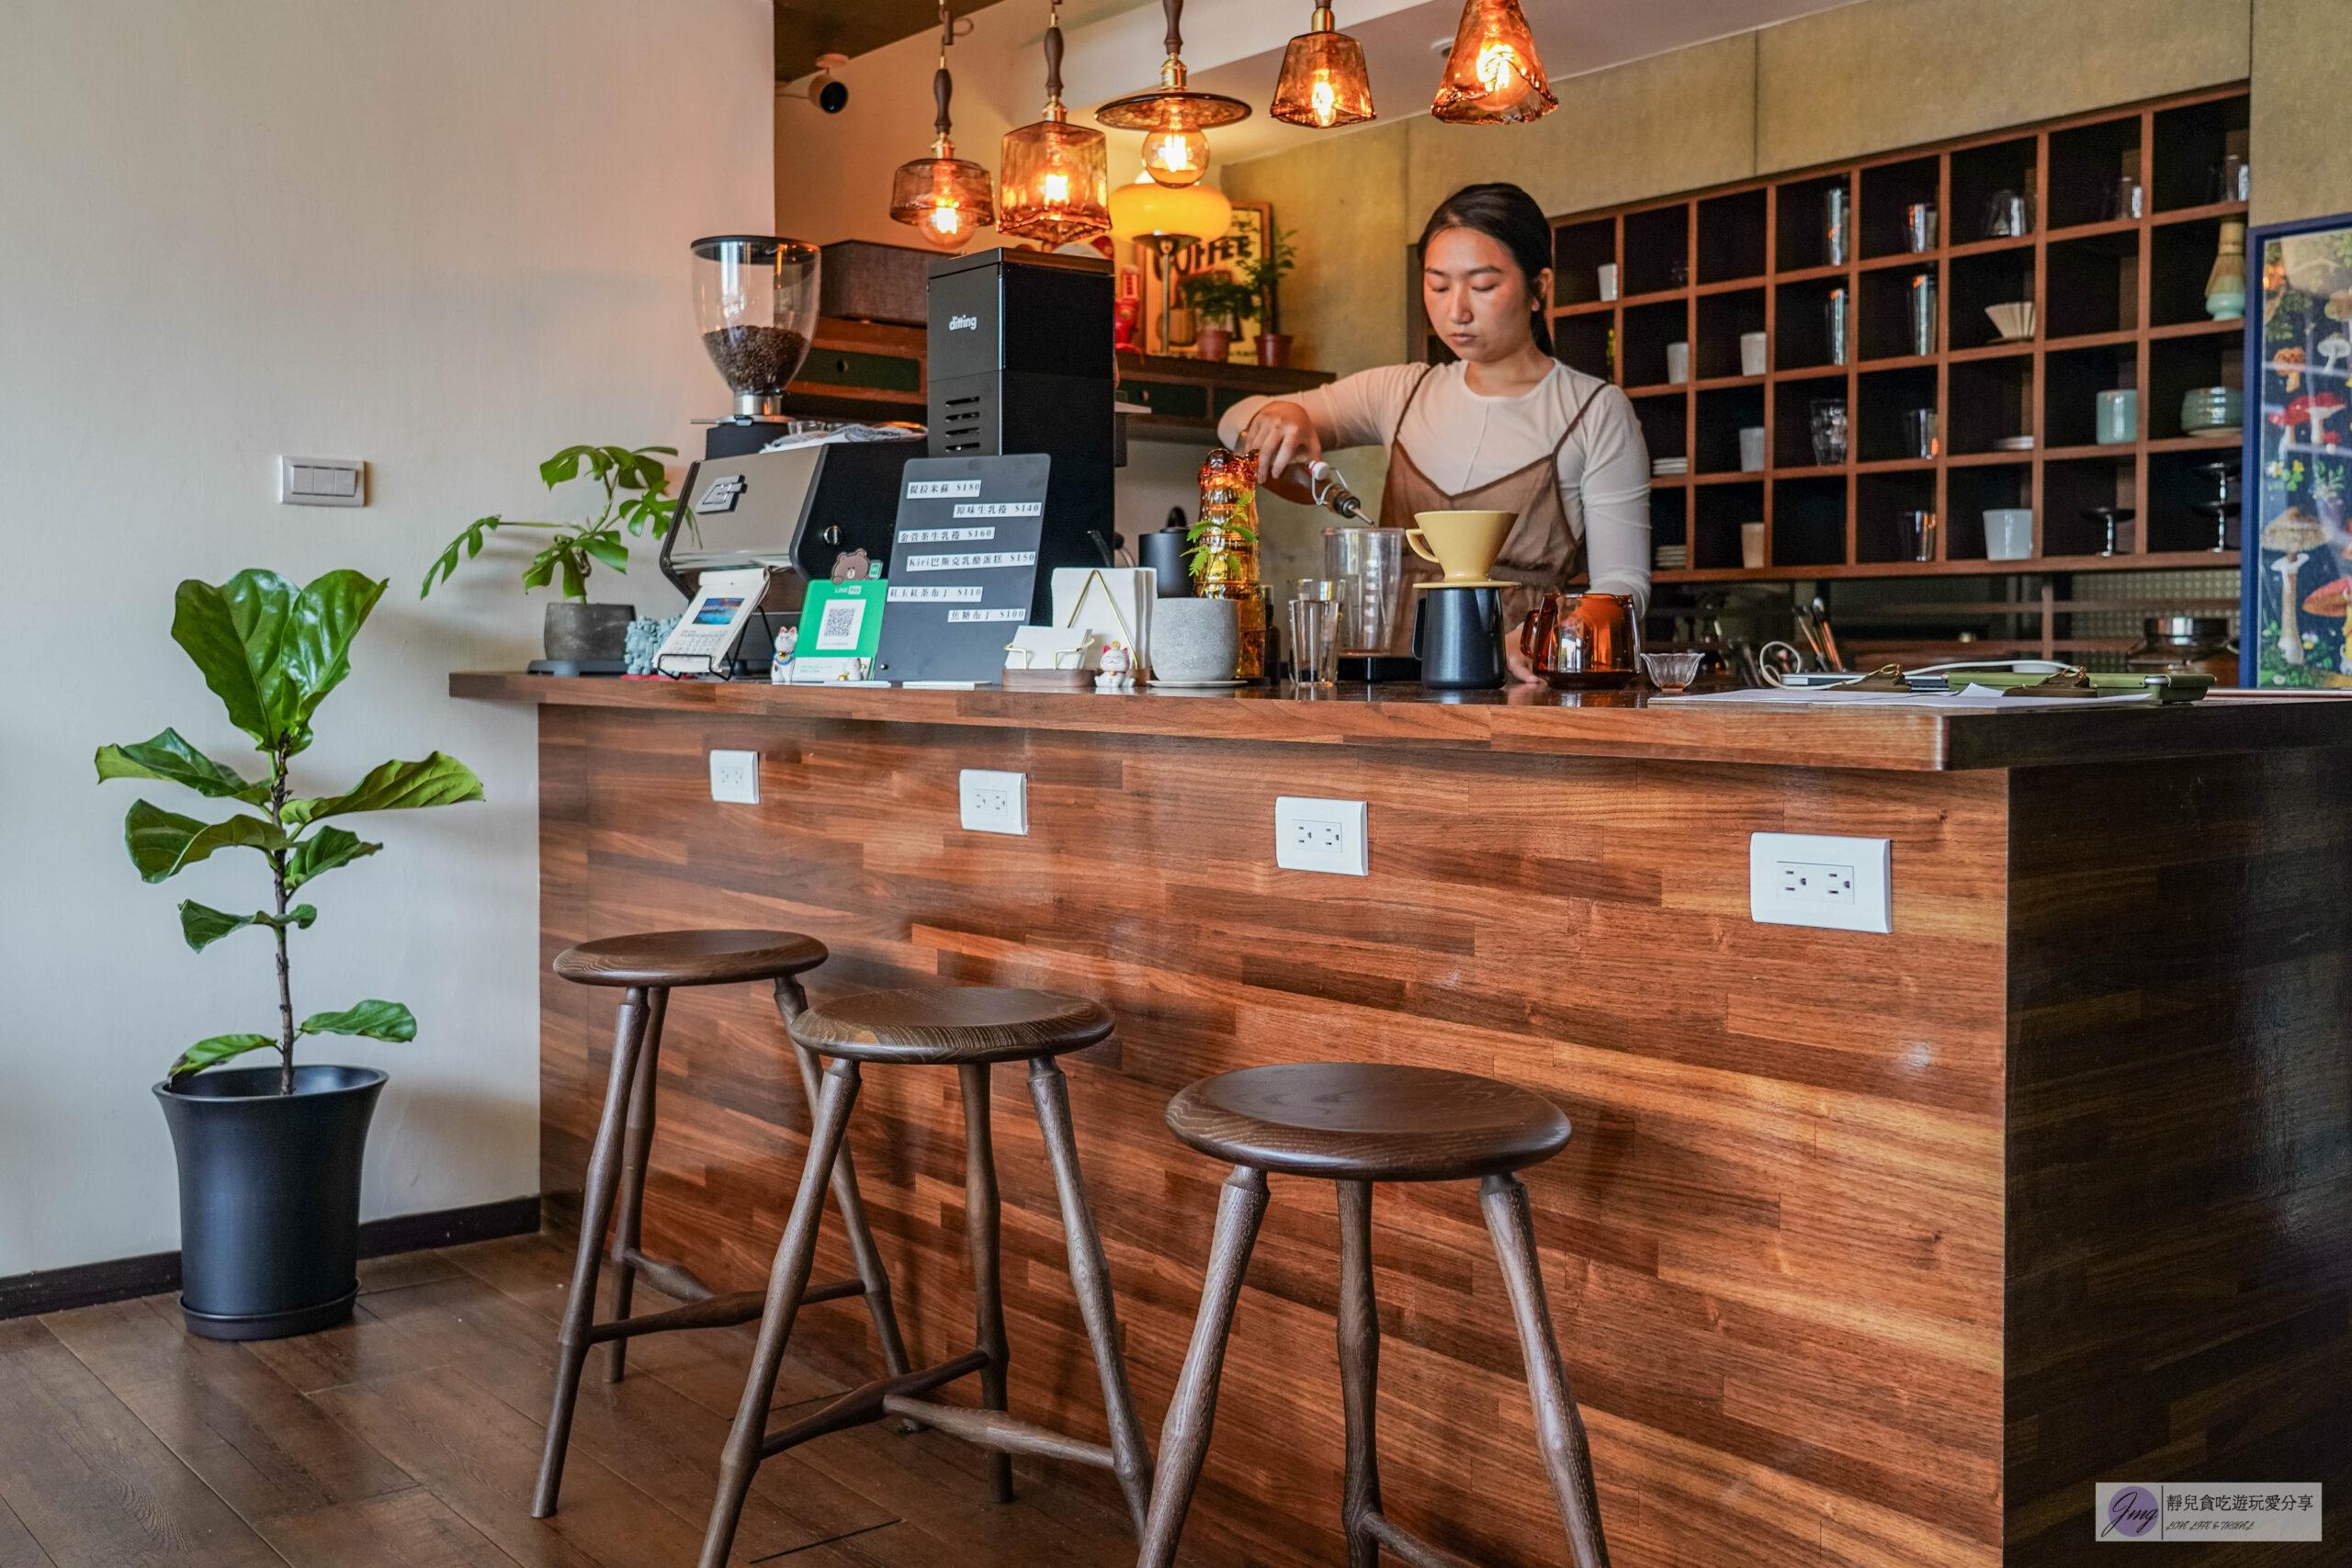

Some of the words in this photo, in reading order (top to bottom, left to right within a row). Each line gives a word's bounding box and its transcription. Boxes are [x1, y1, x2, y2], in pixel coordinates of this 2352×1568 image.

[949, 314, 978, 331] ditting
[910, 484, 949, 494] 提拉米蘇
[956, 482, 980, 491] $180
[1014, 503, 1039, 513] $140
[967, 529, 992, 538] $160
[1010, 553, 1035, 561] $150
[951, 610, 991, 620] 焦糖布丁
